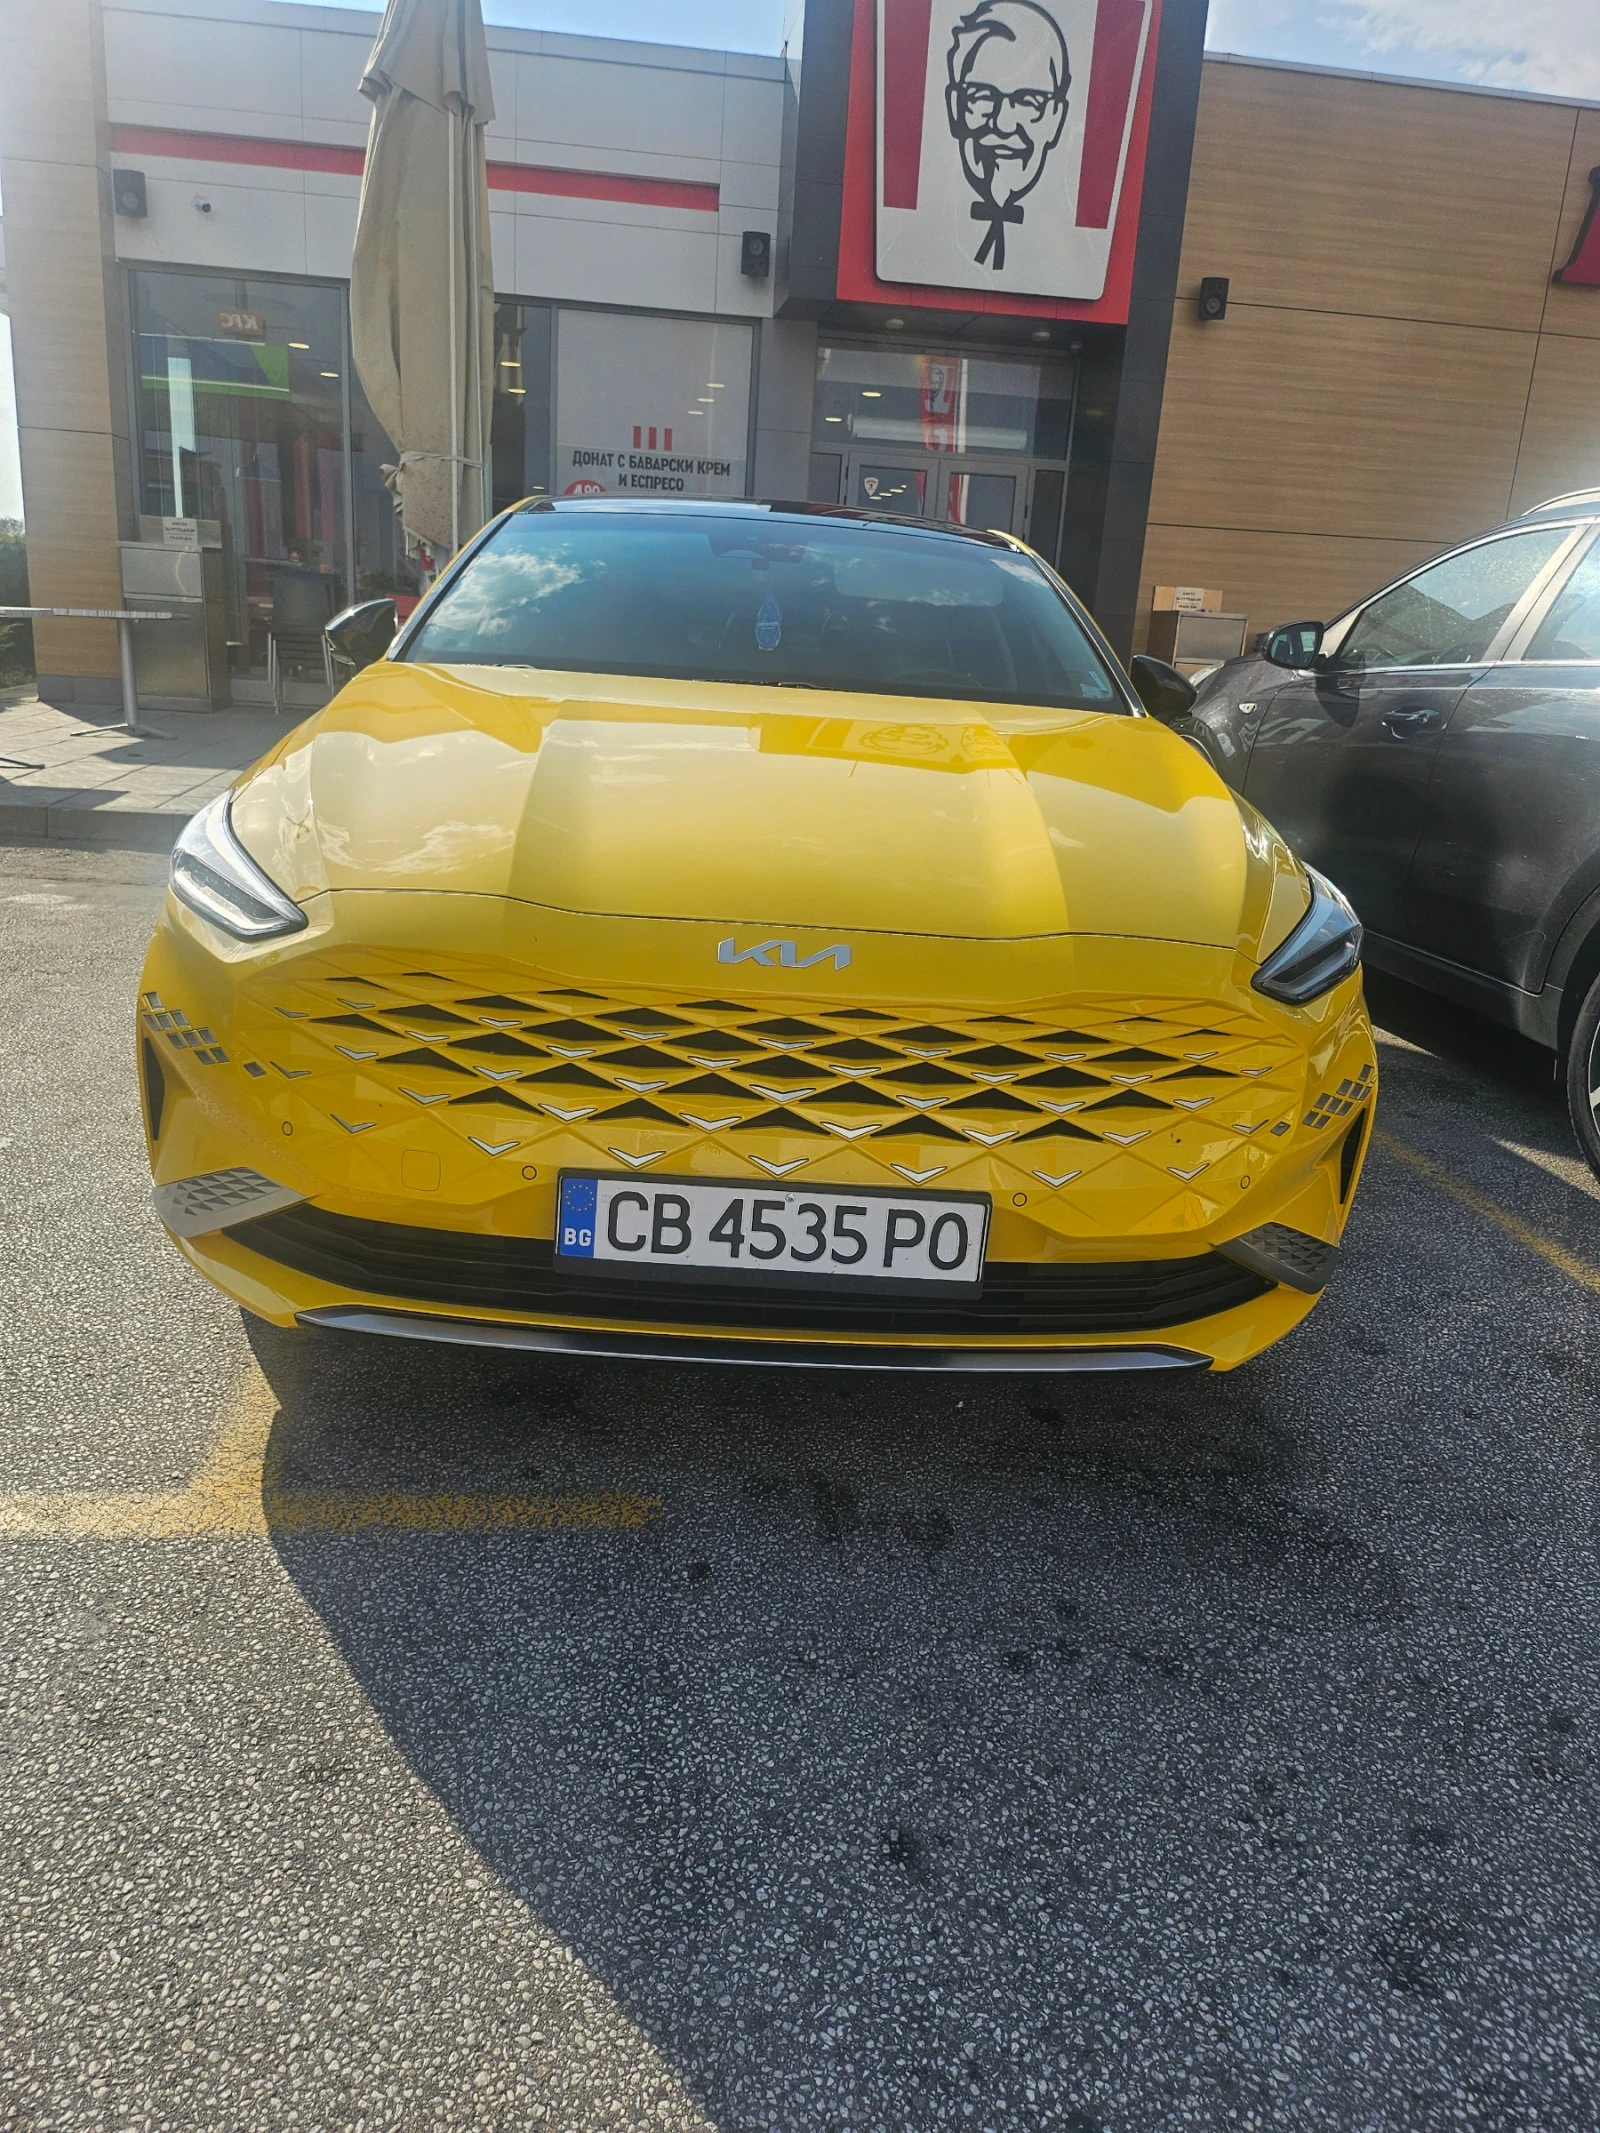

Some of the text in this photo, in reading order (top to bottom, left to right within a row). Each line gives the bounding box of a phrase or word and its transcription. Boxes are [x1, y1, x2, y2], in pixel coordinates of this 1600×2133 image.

[572, 450, 731, 477] ДОНАТ С БАВАРСКИ КРЕМ
[618, 473, 685, 491] И ЕСПРЕСО
[717, 937, 852, 971] KIA
[563, 1227, 592, 1248] BG
[607, 1190, 692, 1255] CB
[709, 1198, 868, 1265] 4535
